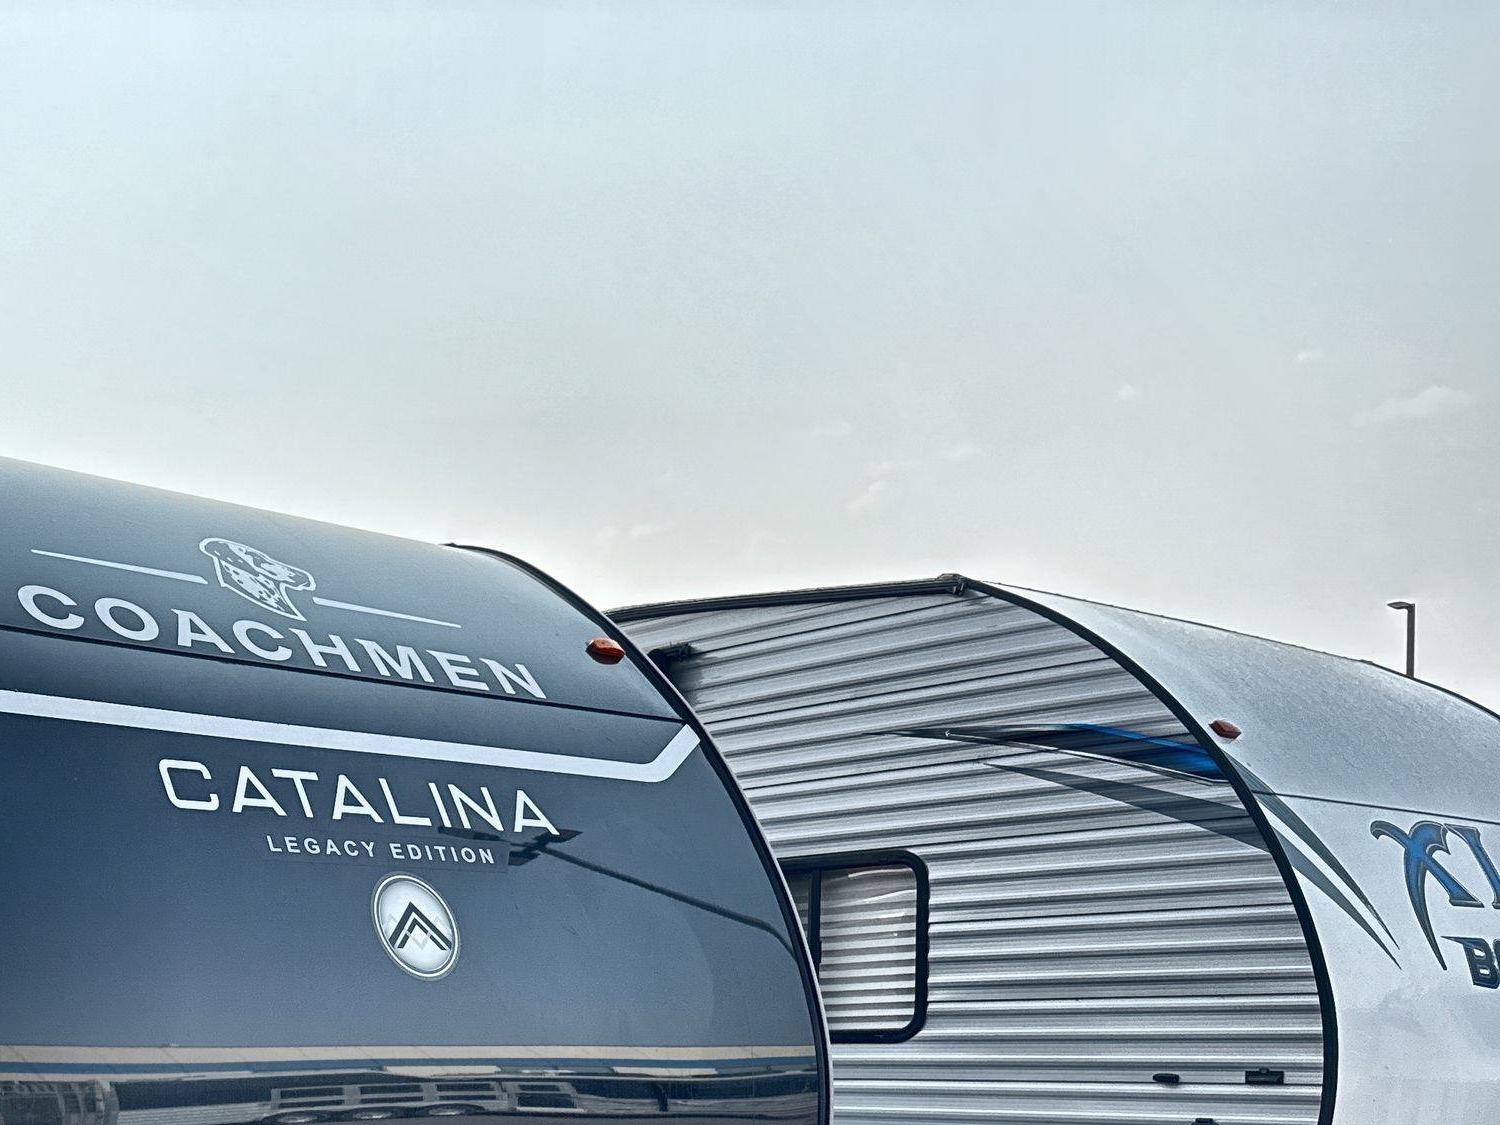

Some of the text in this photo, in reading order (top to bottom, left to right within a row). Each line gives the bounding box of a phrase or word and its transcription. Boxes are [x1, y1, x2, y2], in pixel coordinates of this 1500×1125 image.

[17, 584, 547, 699] COACHMEN
[158, 758, 560, 836] CATALINA
[266, 835, 497, 865] LEGACY EDITION
